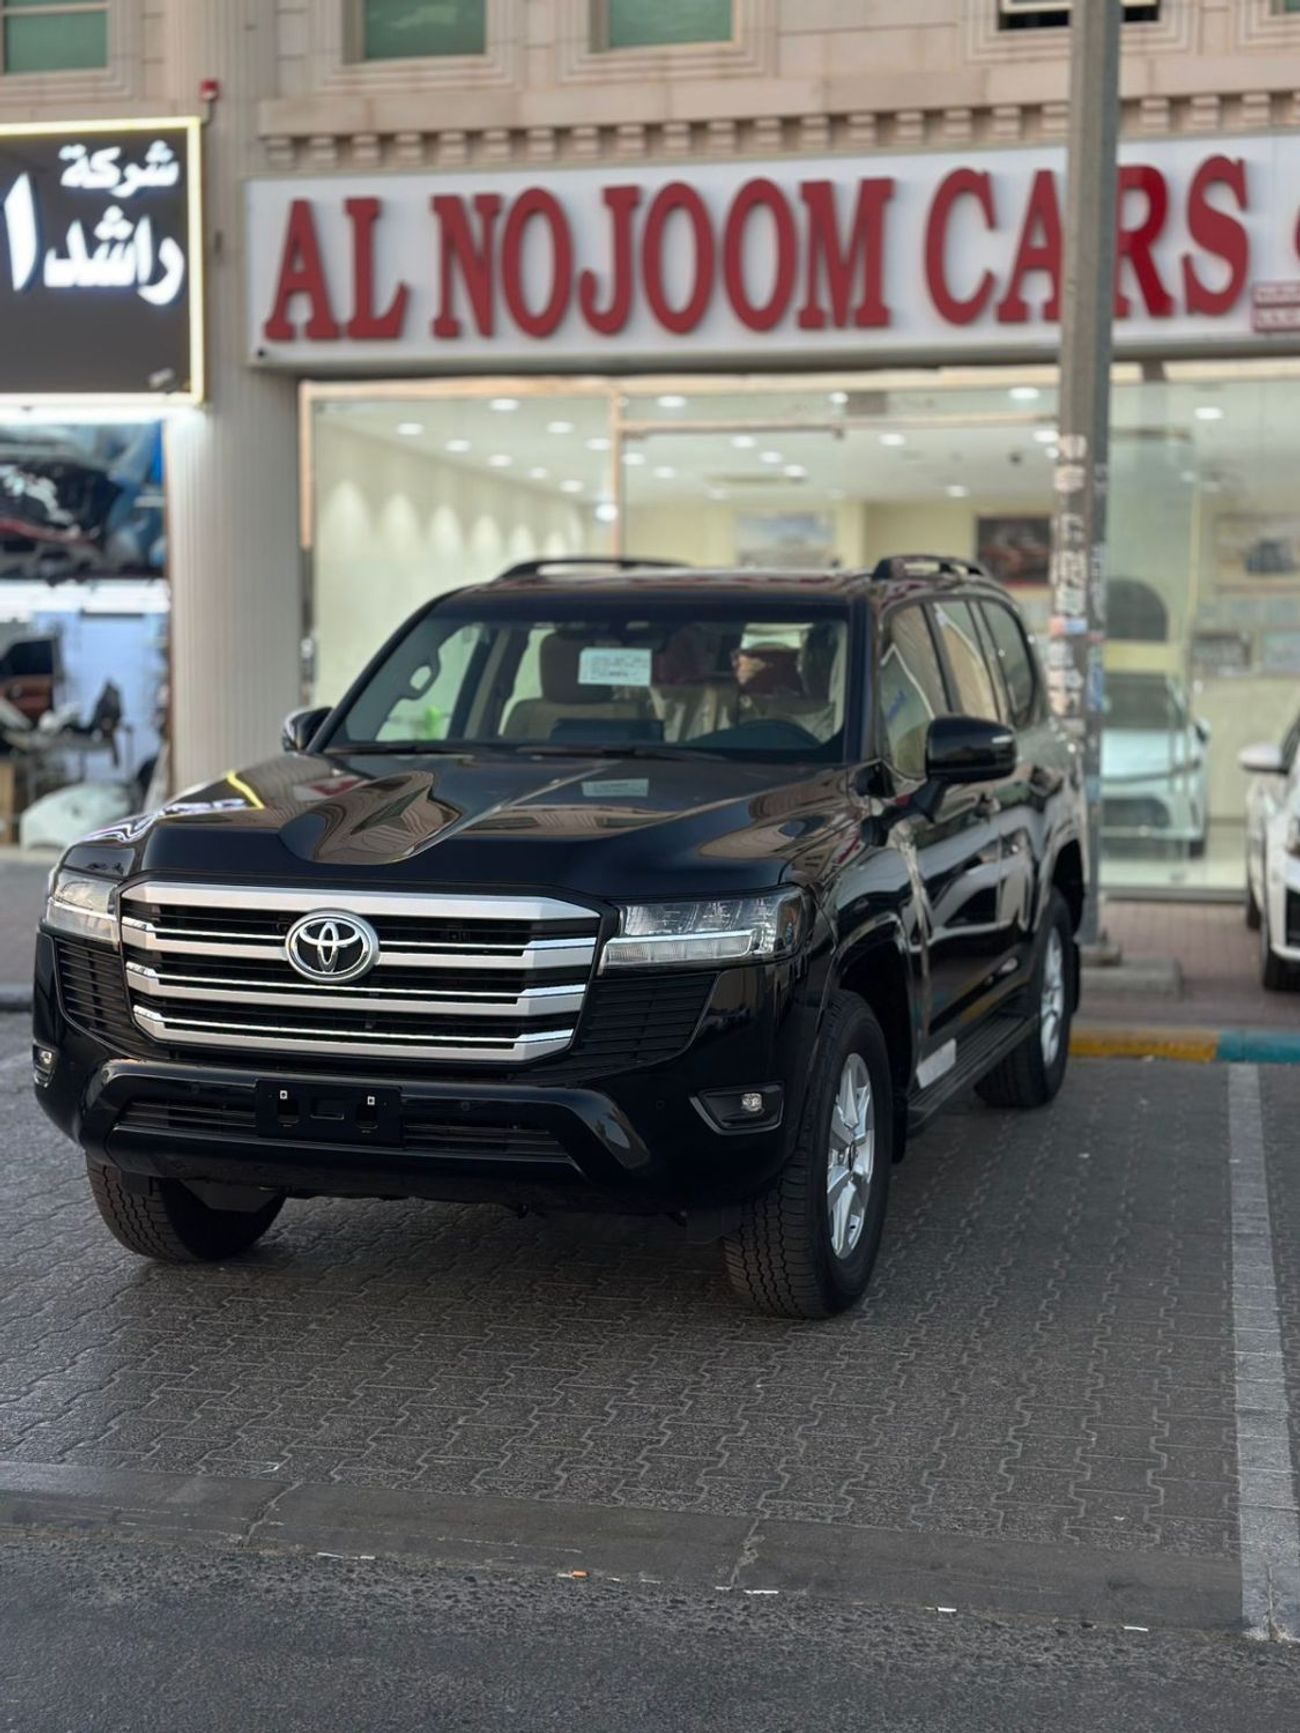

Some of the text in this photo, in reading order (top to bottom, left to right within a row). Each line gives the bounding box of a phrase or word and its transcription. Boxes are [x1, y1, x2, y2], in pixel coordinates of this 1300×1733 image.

[58, 139, 180, 198] شركة
[264, 155, 1250, 341] AL NOJOOM CARS
